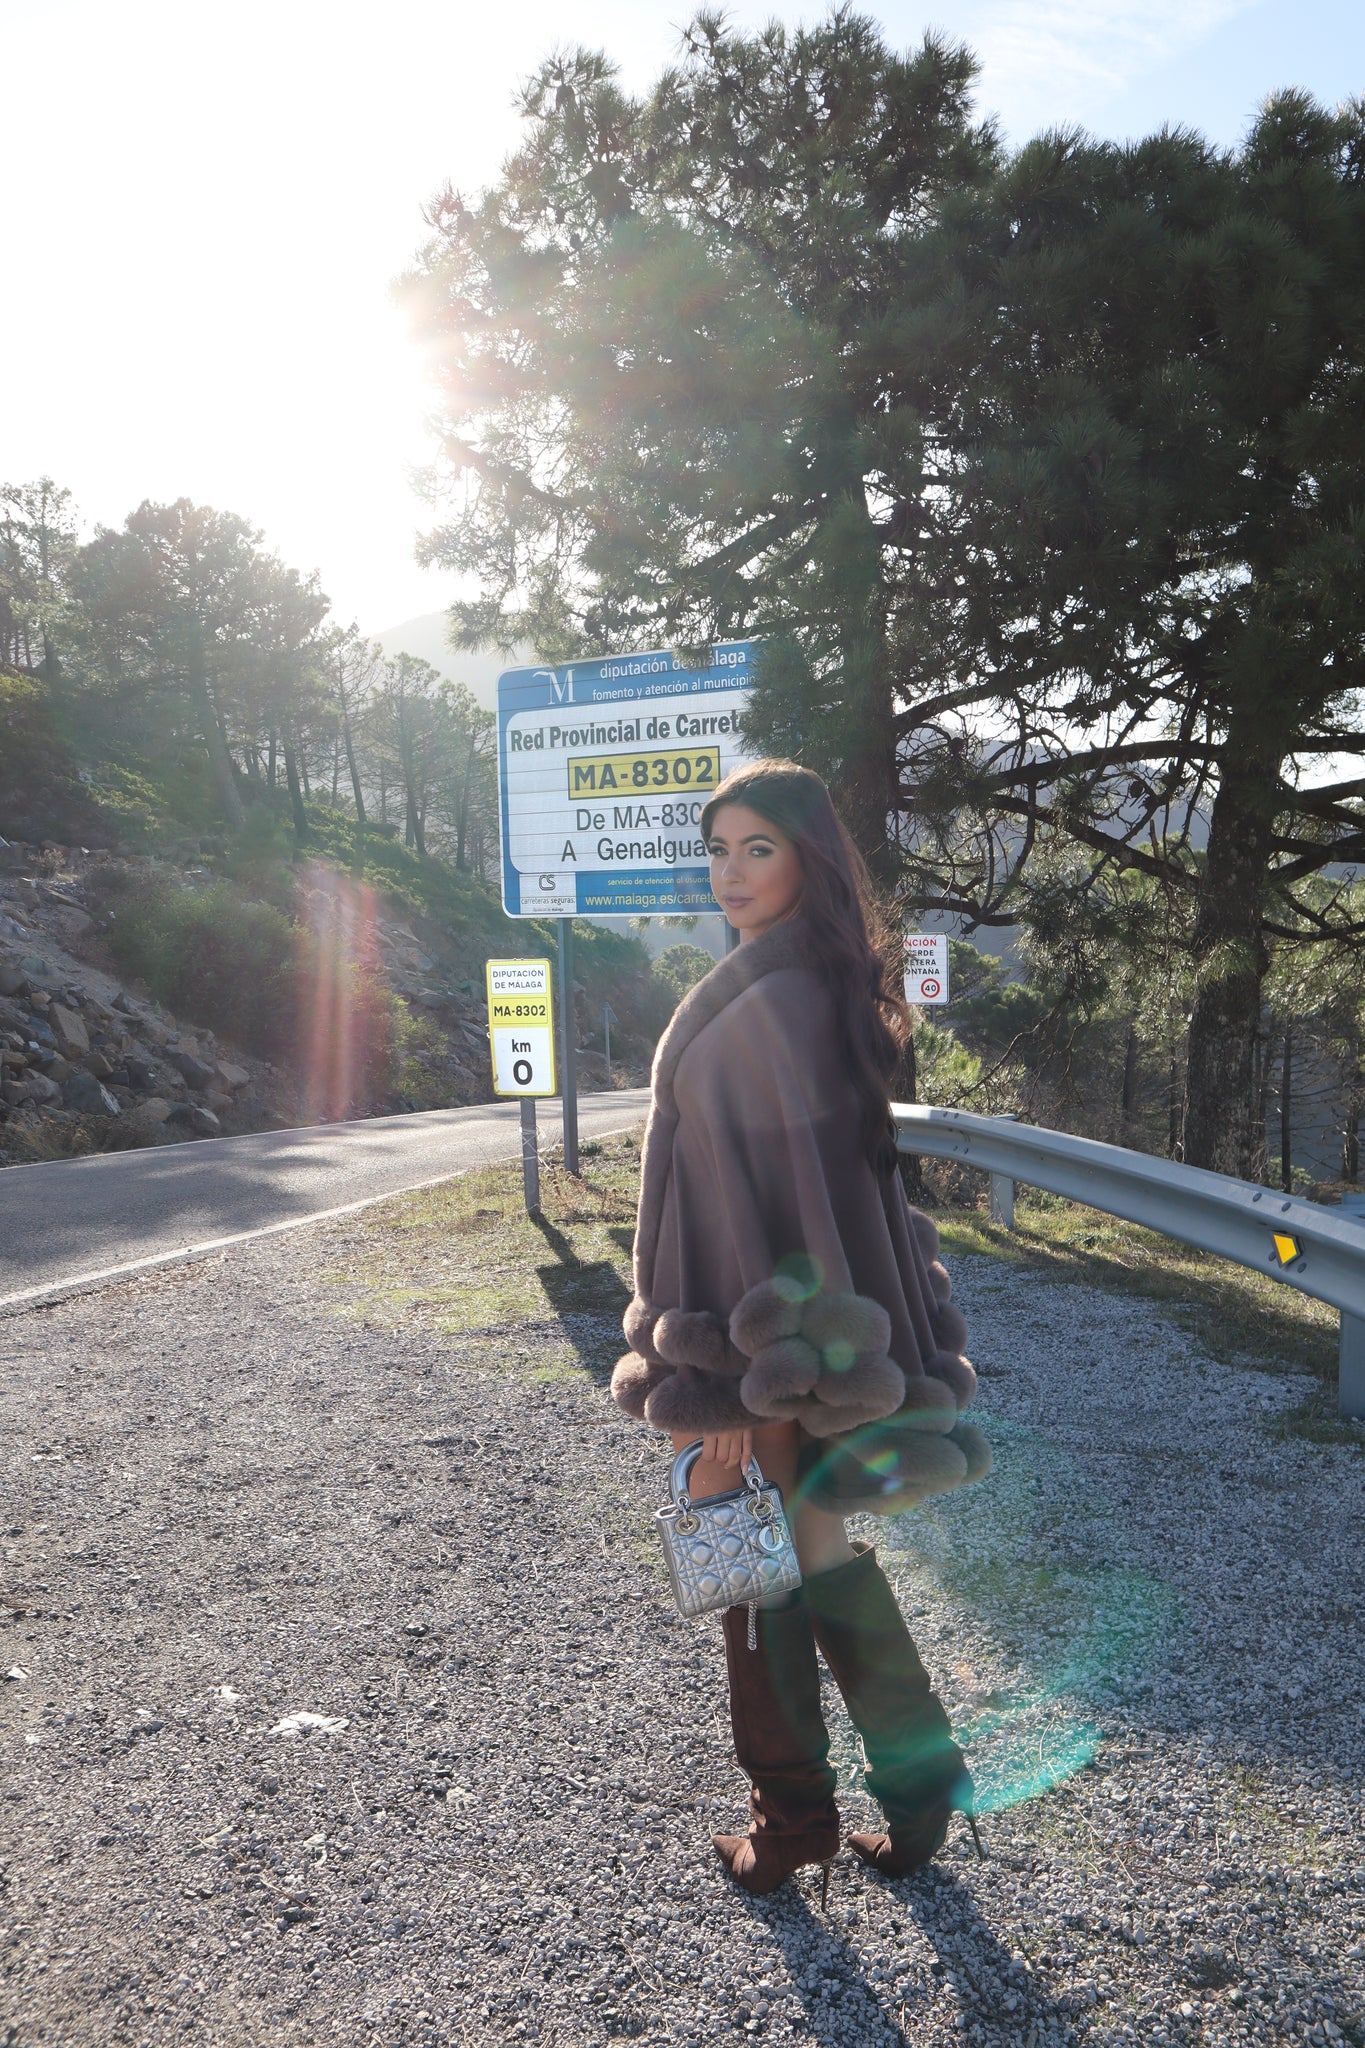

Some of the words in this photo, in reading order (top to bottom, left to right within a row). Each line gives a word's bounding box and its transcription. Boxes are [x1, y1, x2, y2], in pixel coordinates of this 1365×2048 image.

[600, 657, 668, 682] diputación
[592, 687, 634, 701] fomento
[636, 688, 643, 699] y
[645, 681, 688, 696] atención
[691, 678, 701, 691] al
[704, 672, 756, 689] municipio
[511, 727, 544, 752] Red
[550, 718, 641, 748] Provincial
[647, 716, 670, 739] de
[675, 710, 743, 737] Carret
[574, 755, 714, 791] MA-8302
[576, 809, 605, 831] De
[613, 801, 701, 830] MA-830
[561, 840, 577, 862] A
[597, 836, 708, 864] Genalgua
[607, 877, 632, 886] servicio
[635, 876, 643, 885] de
[645, 876, 674, 885] atención
[677, 876, 683, 884] al
[521, 897, 549, 905] carreteras
[585, 890, 717, 909] www.malaga.es/carrete
[905, 937, 937, 947] NCIÓN
[911, 958, 936, 966] ETERA
[492, 969, 544, 978] DIPUTACIÓN
[905, 967, 939, 975] ONTAÑA
[494, 981, 506, 989] DE
[493, 1005, 546, 1017] MA-8302
[511, 1039, 532, 1053] km
